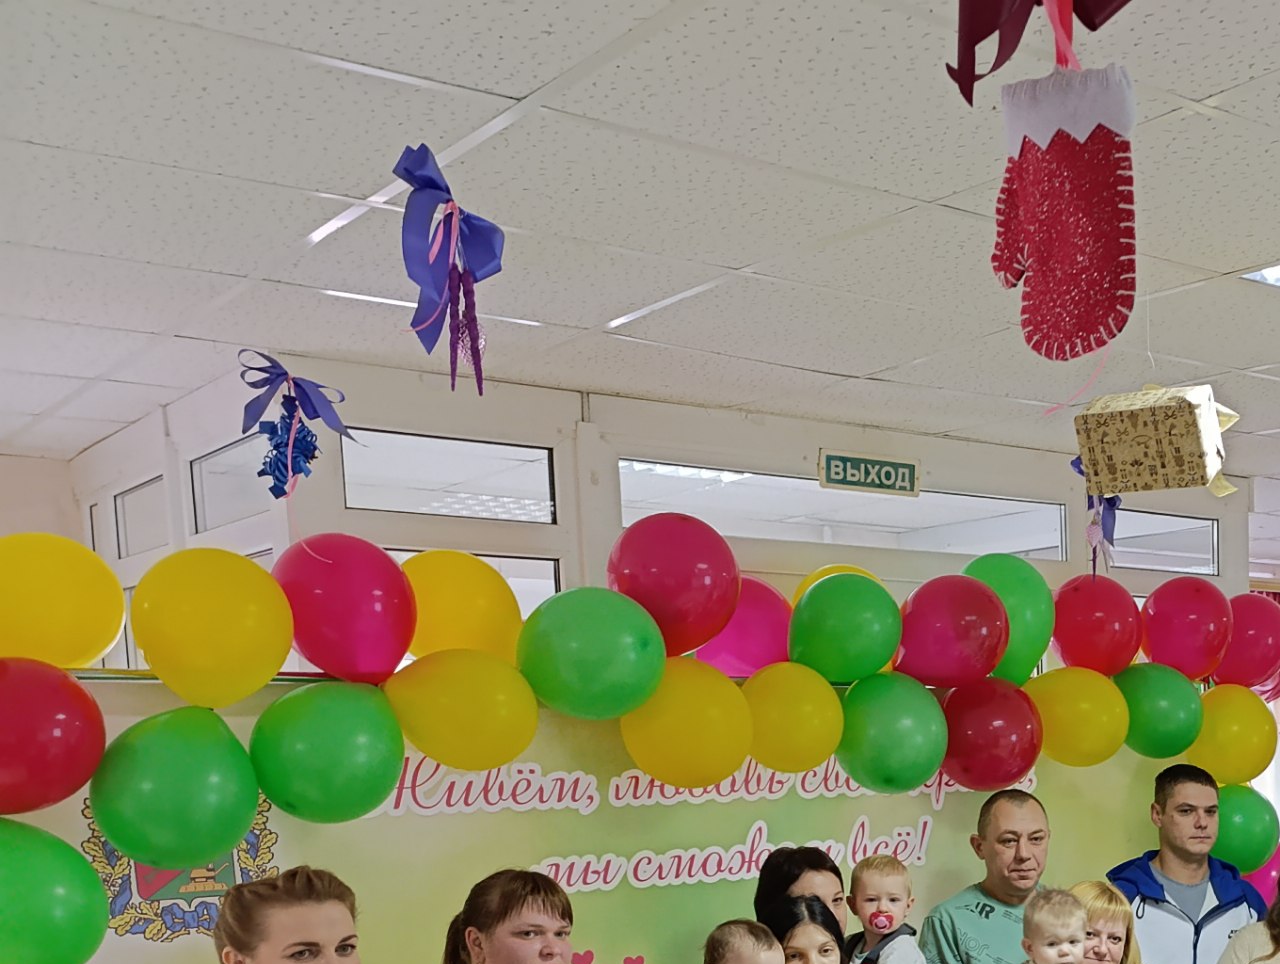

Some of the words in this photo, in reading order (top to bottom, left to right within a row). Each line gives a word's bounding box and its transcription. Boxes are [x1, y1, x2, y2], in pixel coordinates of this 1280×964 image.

[830, 460, 911, 490] ВЫХОД
[393, 755, 594, 809] Живём,
[633, 826, 841, 883] смож
[851, 820, 929, 864] всё!
